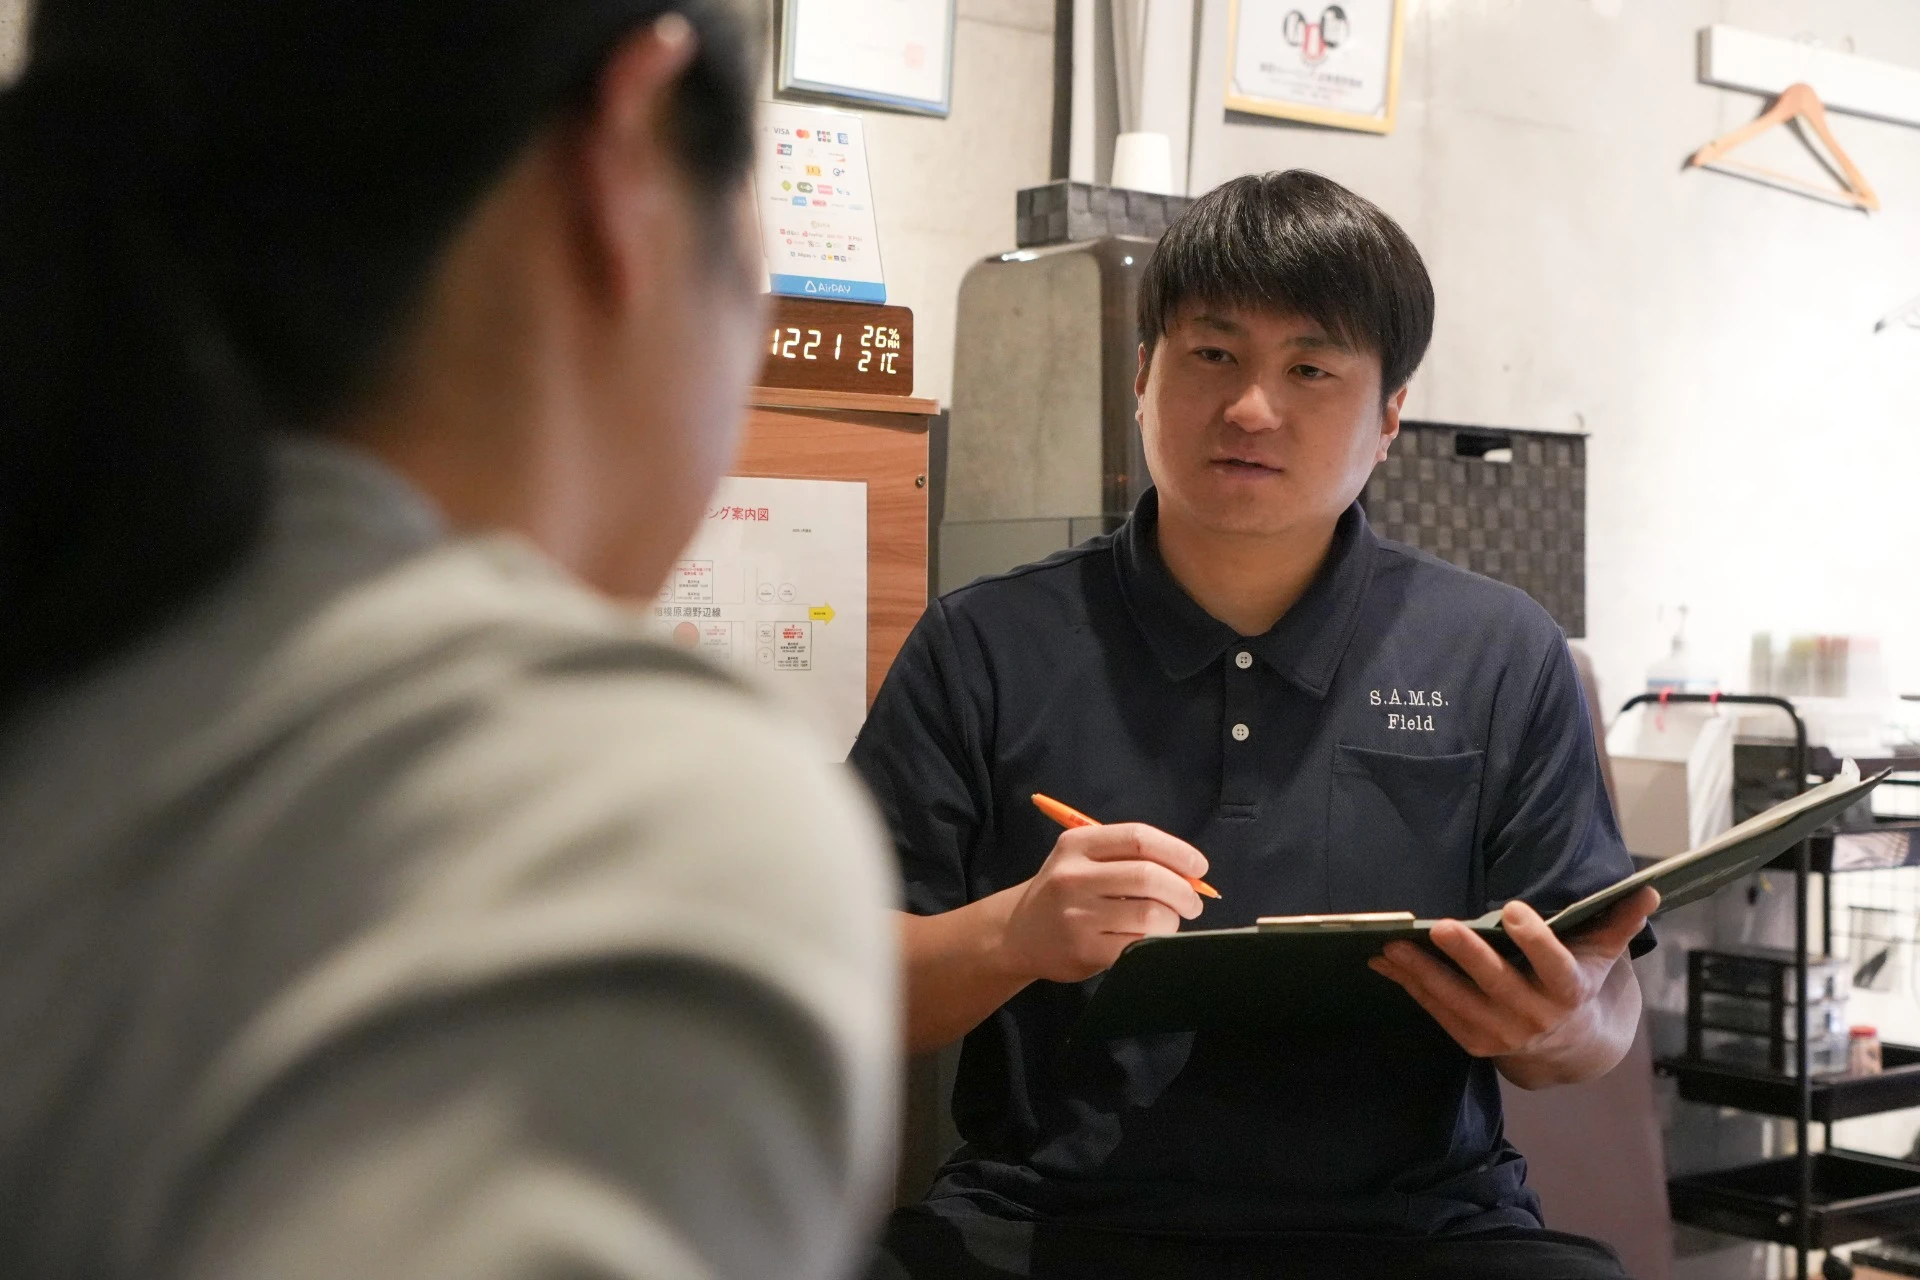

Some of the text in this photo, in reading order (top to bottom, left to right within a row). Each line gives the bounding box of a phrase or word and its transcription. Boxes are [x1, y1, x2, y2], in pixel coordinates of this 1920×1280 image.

[773, 126, 790, 136] VISA
[818, 282, 851, 294] AirPAY
[706, 506, 769, 521] ング案内図
[1369, 688, 1449, 707] S.A.M.S.
[1387, 713, 1435, 731] Field
